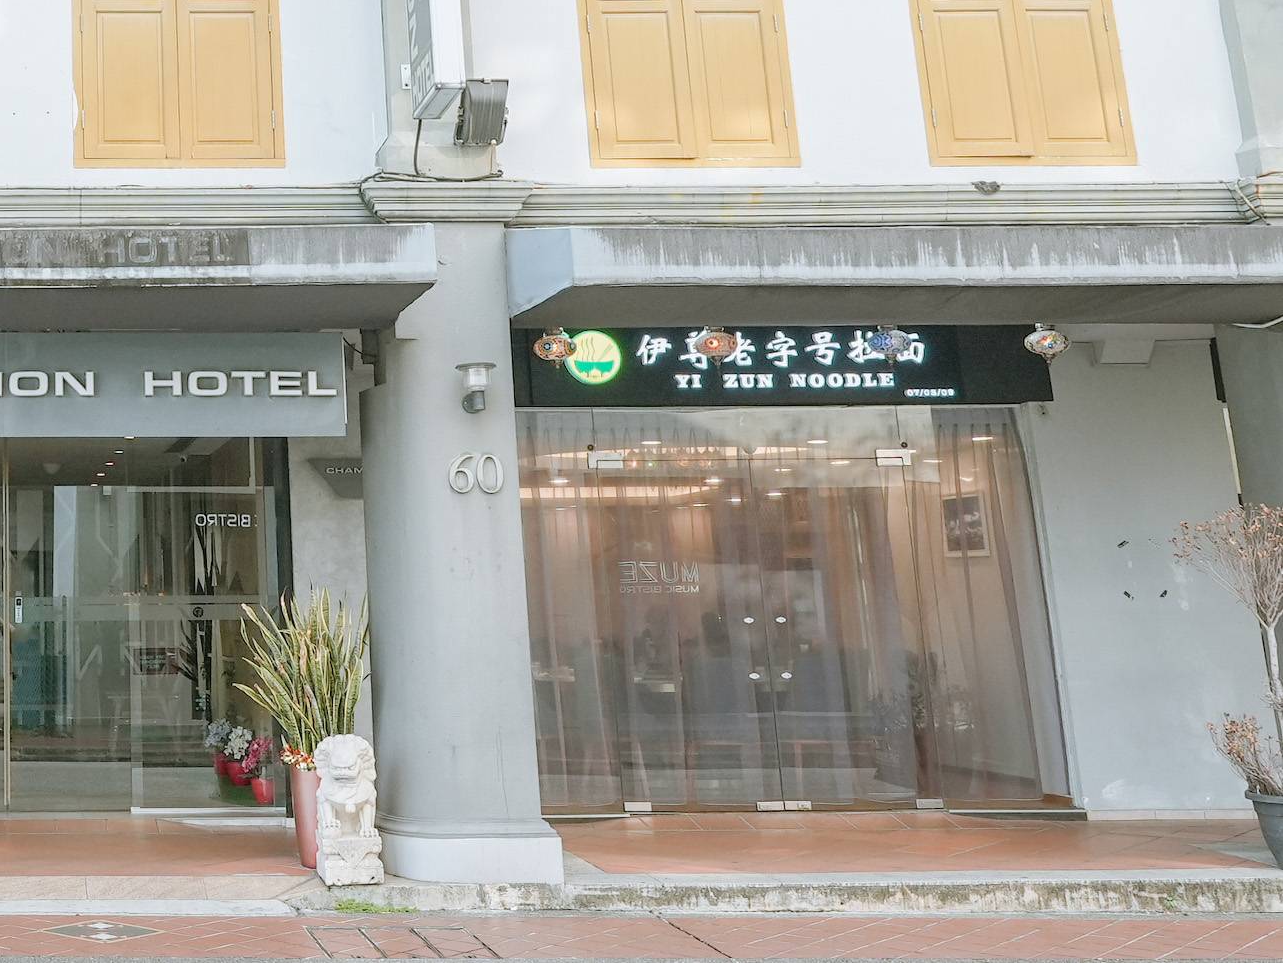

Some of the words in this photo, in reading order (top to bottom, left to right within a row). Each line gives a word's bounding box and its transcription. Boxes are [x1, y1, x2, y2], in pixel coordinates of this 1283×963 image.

[143, 370, 339, 398] HOTEL
[673, 373, 703, 388] YI
[722, 373, 774, 389] ZUN
[788, 372, 896, 388] NOODLE
[448, 454, 504, 494] 60
